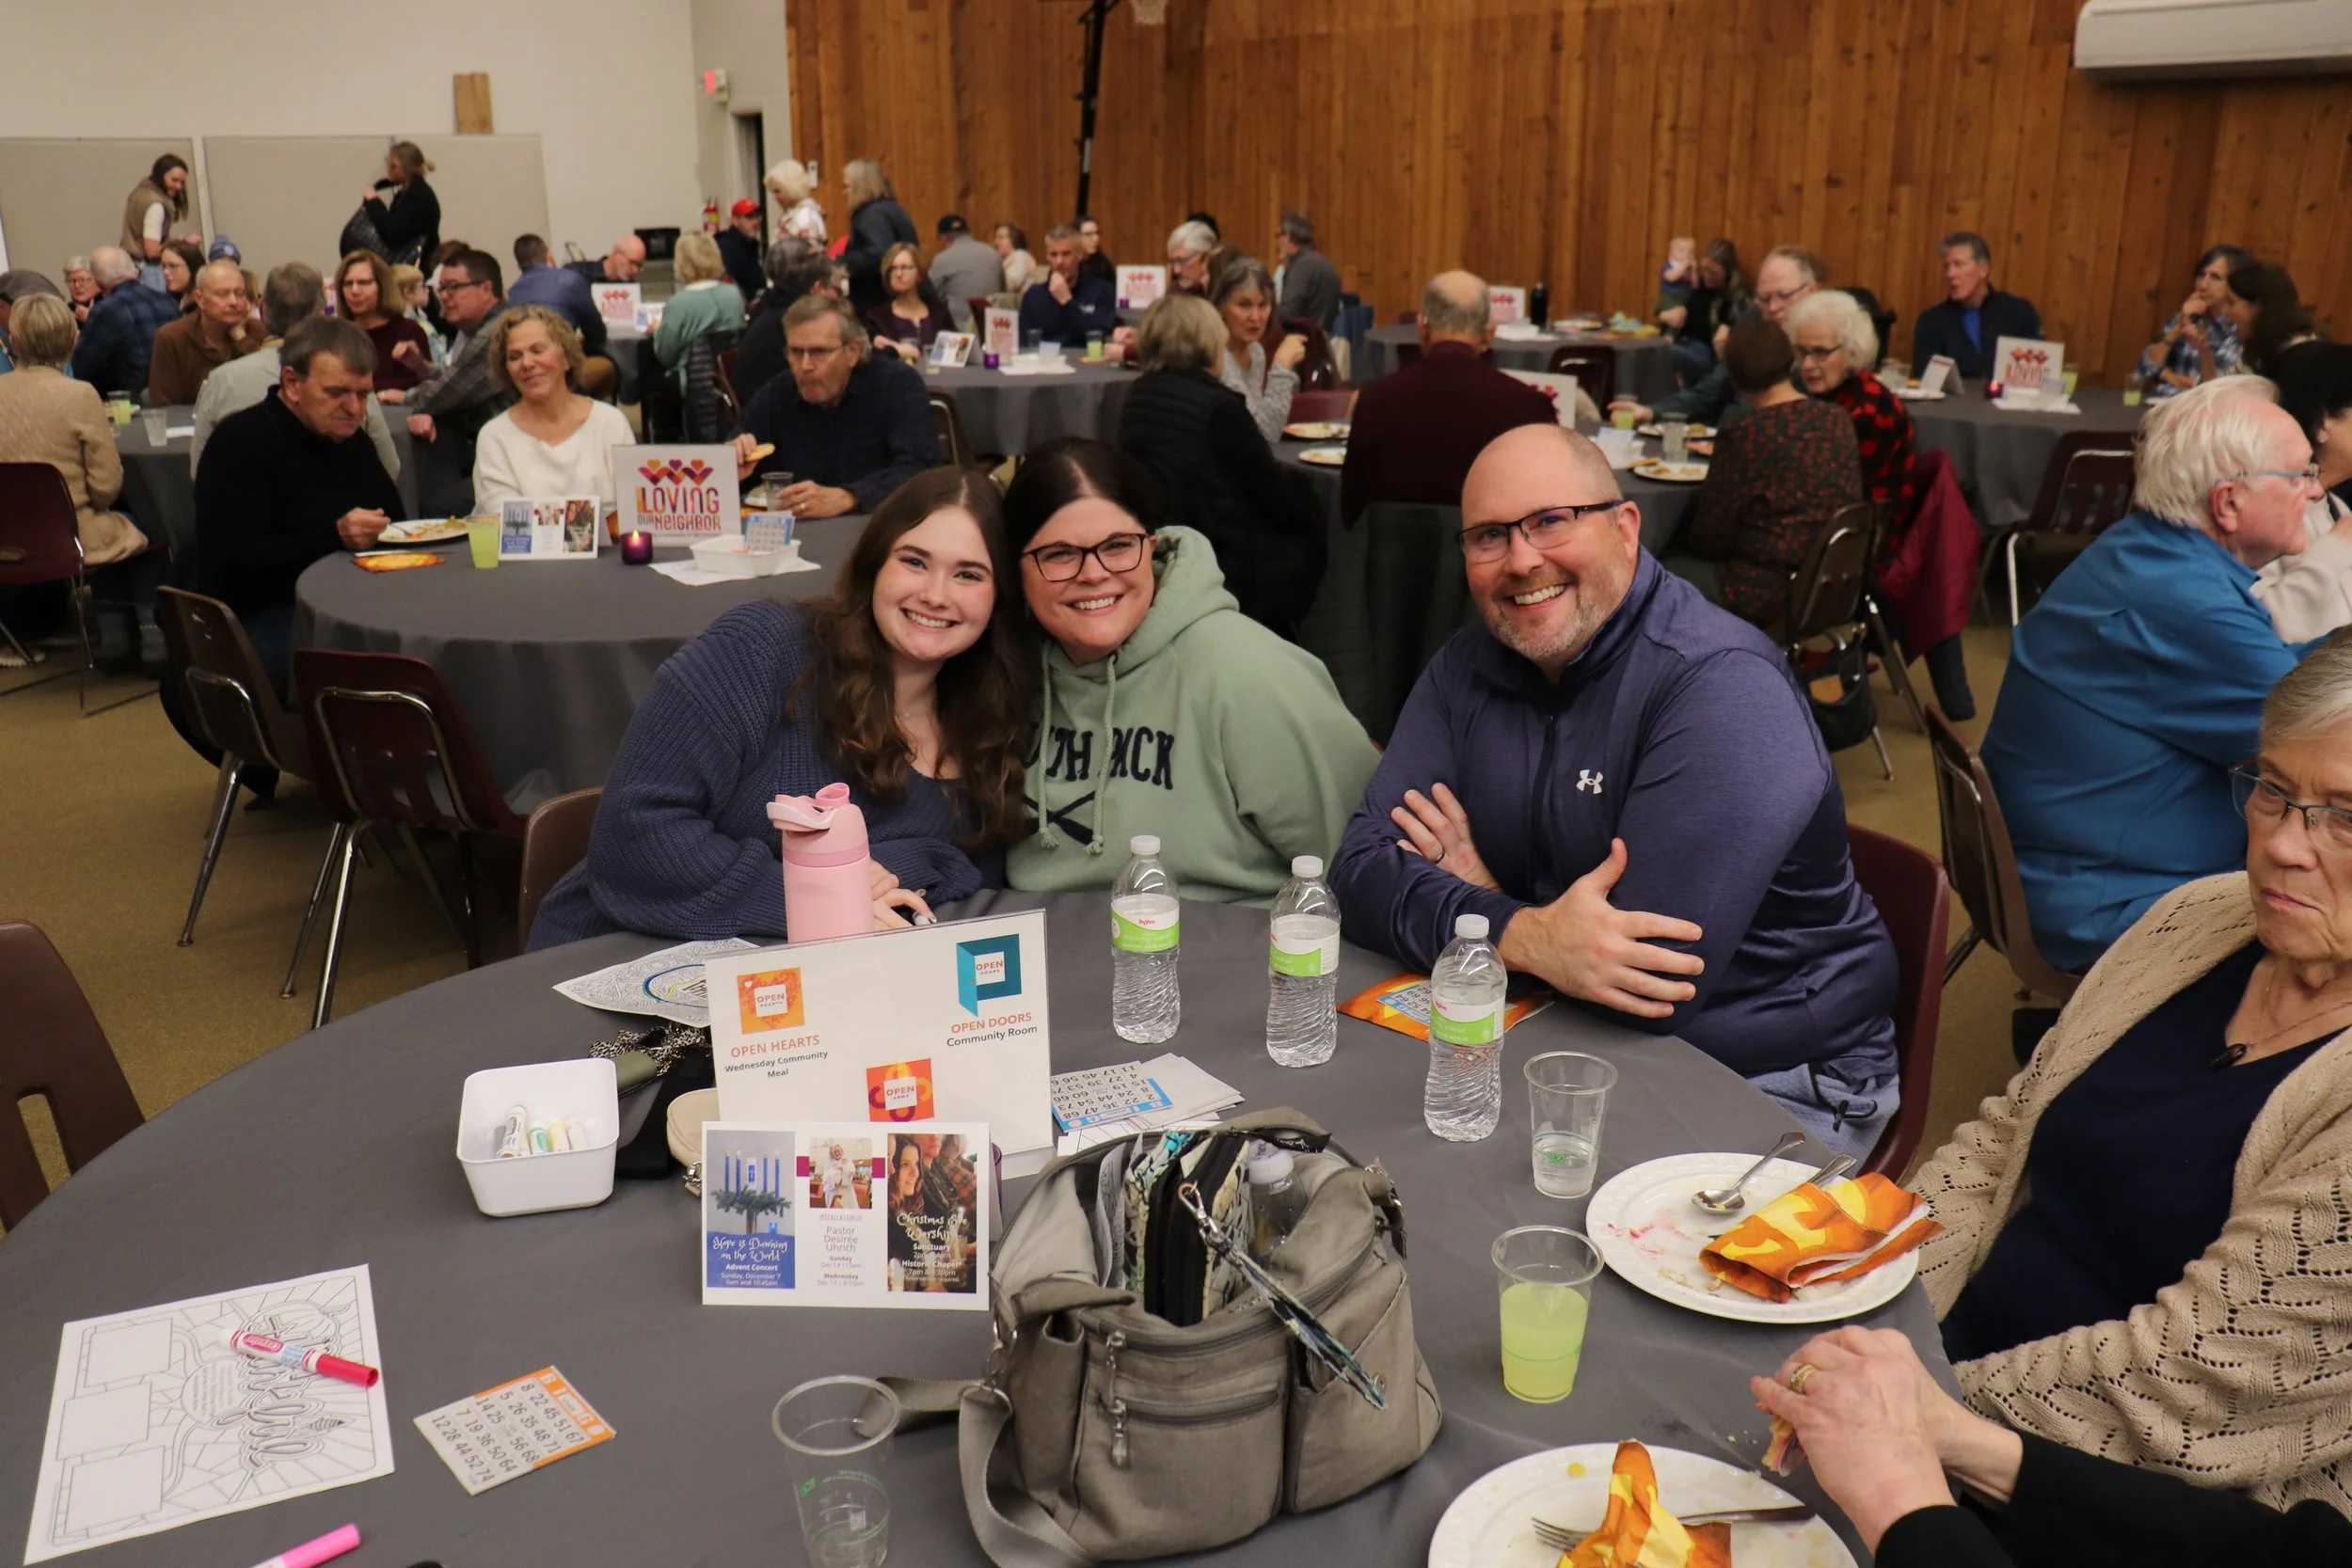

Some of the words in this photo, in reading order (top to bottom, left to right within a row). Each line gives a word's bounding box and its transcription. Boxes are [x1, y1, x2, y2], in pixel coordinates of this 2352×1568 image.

[976, 960, 1003, 971] OPEN
[756, 993, 785, 1003] OPEN
[951, 1020, 985, 1033] OPEN
[989, 1012, 1032, 1027] DOORS
[946, 1031, 1006, 1046] Community
[1008, 1026, 1037, 1037] Room
[731, 1043, 767, 1058] OPEN
[771, 1035, 820, 1052] HEARTS
[725, 1059, 775, 1072] Wednesday
[777, 1052, 828, 1065] Community
[768, 1069, 788, 1078] Meal
[886, 1085, 914, 1096] OPEN
[897, 1212, 945, 1226] Christmas
[712, 1236, 735, 1250] Hope
[739, 1240, 746, 1249] is
[749, 1238, 788, 1253] Dawning
[913, 1243, 951, 1252] Sanctuary
[734, 1250, 746, 1260] the
[749, 1250, 780, 1262] World
[500, 1391, 515, 1402] 5
[507, 1402, 523, 1416] 26
[520, 1383, 535, 1392] 8
[530, 1393, 548, 1408] 22
[543, 1407, 562, 1420] 45
[553, 1419, 572, 1433] 51
[565, 1431, 585, 1444] 67
[520, 1415, 540, 1429] 35
[475, 1398, 496, 1412] 14
[486, 1411, 506, 1425] 25
[510, 1436, 527, 1451] 56
[522, 1449, 541, 1464] 68
[533, 1428, 550, 1442] 48
[455, 1408, 470, 1418] 7
[465, 1419, 484, 1433] 19
[476, 1432, 496, 1447] 36
[488, 1445, 507, 1461] 50
[499, 1458, 517, 1473] 64
[543, 1441, 562, 1454] 71
[432, 1415, 449, 1430] 12
[442, 1428, 461, 1442] 28
[454, 1442, 473, 1456] 44
[464, 1455, 484, 1469] 52
[476, 1468, 496, 1483] 74
